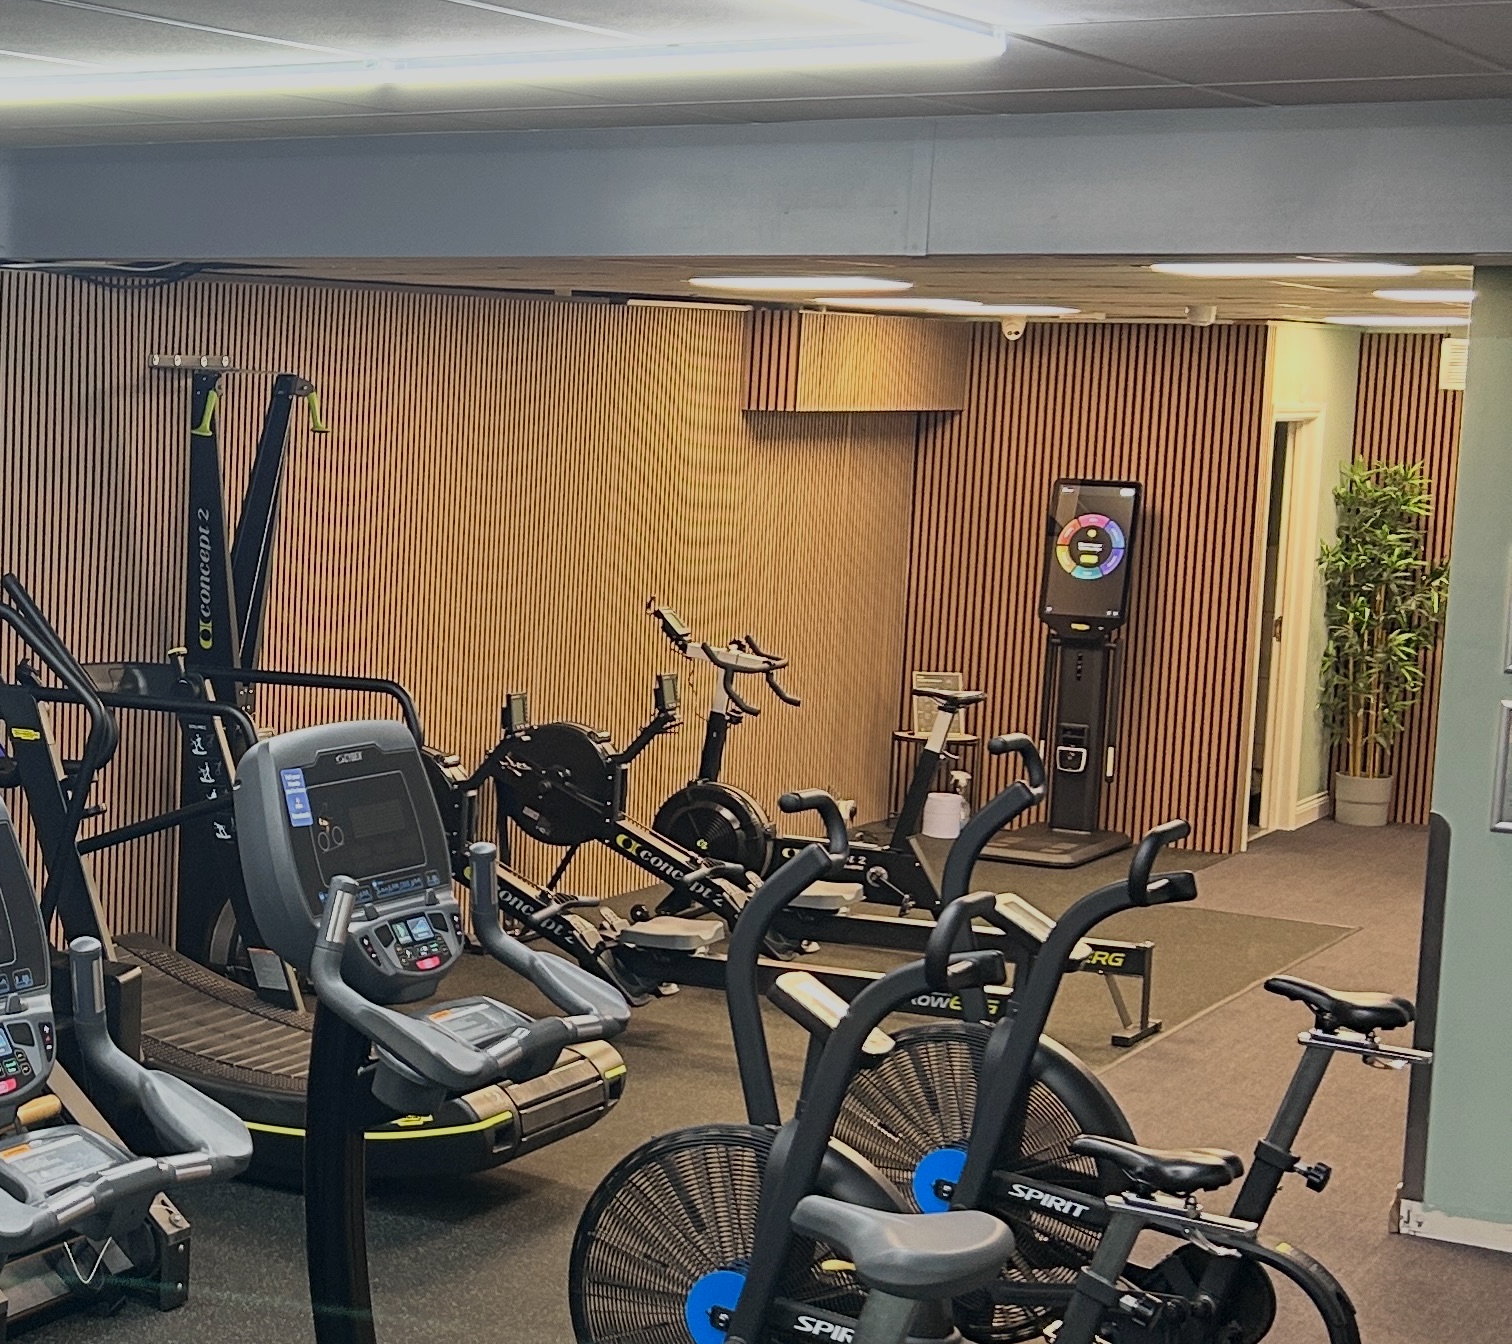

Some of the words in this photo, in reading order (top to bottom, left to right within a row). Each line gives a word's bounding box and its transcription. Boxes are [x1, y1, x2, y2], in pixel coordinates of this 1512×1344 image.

[197, 507, 211, 522] 2
[198, 525, 212, 618] concept
[639, 849, 714, 901] concpt
[497, 887, 563, 936] oncpt
[1007, 1182, 1090, 1219] SPIRIT
